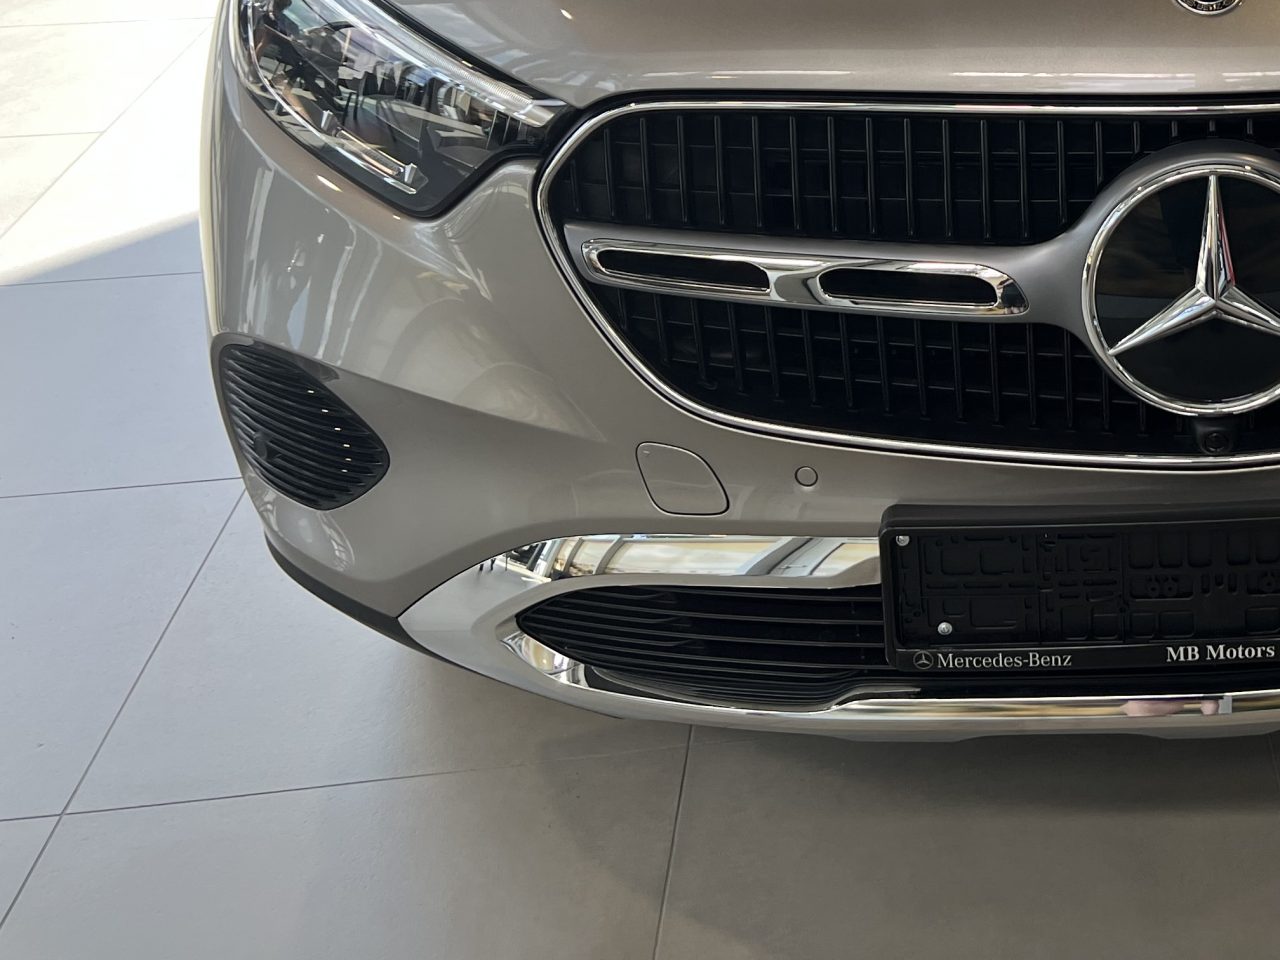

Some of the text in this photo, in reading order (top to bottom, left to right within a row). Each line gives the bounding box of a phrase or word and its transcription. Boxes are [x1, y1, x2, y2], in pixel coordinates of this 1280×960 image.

[937, 652, 1072, 669] Mercedes-Benz
[1166, 644, 1275, 662] MB Motors
